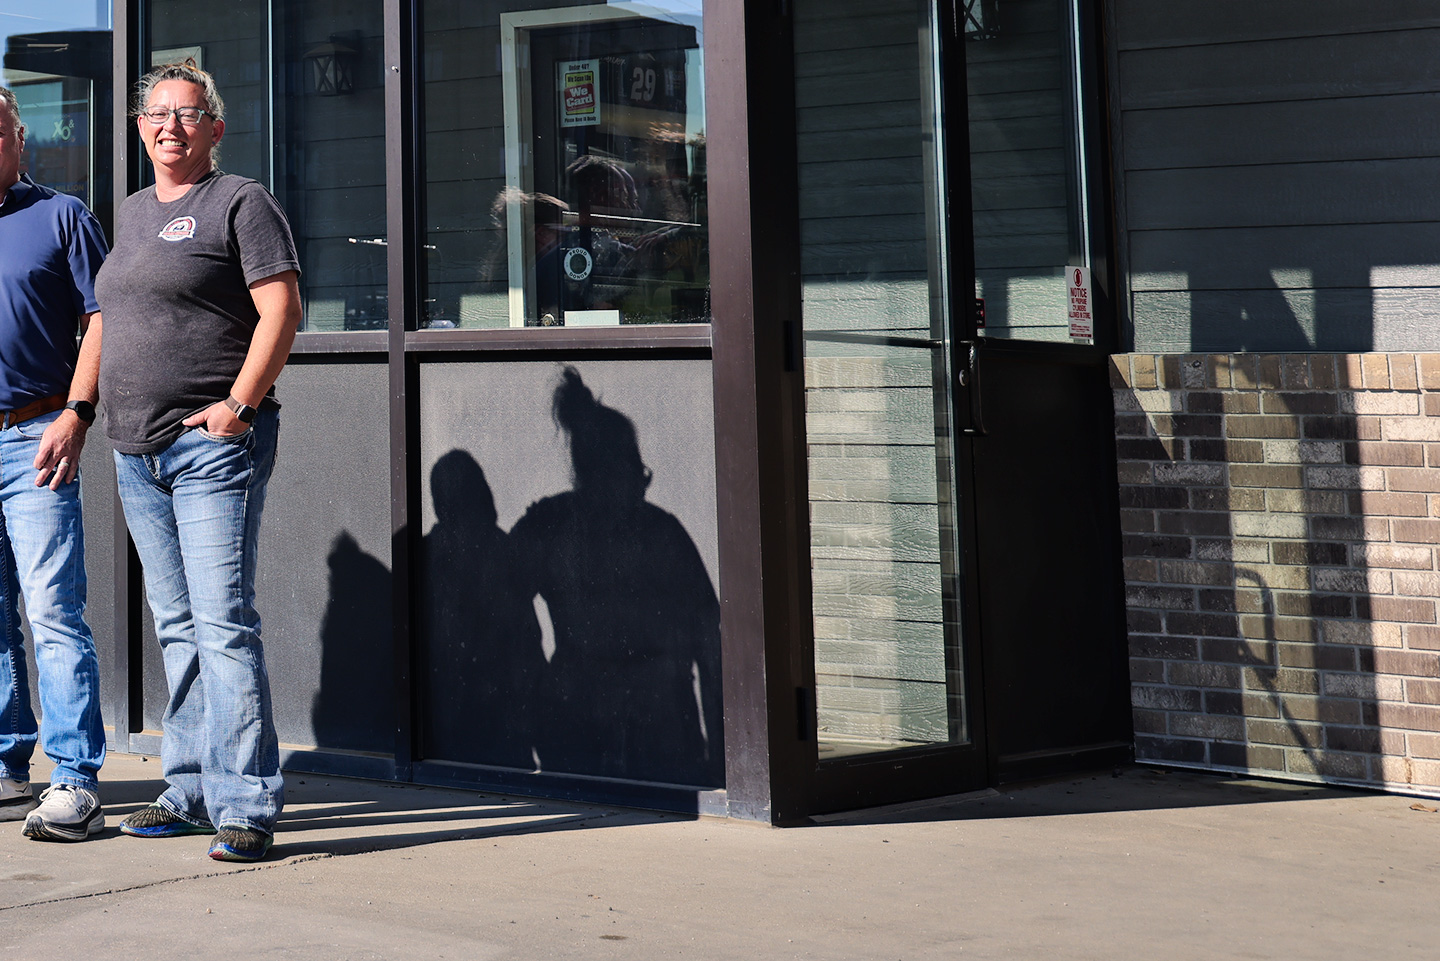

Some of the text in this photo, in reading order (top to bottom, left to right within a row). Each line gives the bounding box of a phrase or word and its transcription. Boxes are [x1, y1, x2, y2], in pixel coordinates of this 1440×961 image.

[630, 67, 656, 102] 29
[570, 86, 588, 97] We
[566, 94, 593, 108] Card
[569, 248, 587, 256] PROUD
[569, 272, 588, 280] DONOR
[1070, 287, 1088, 298] NOTICE
